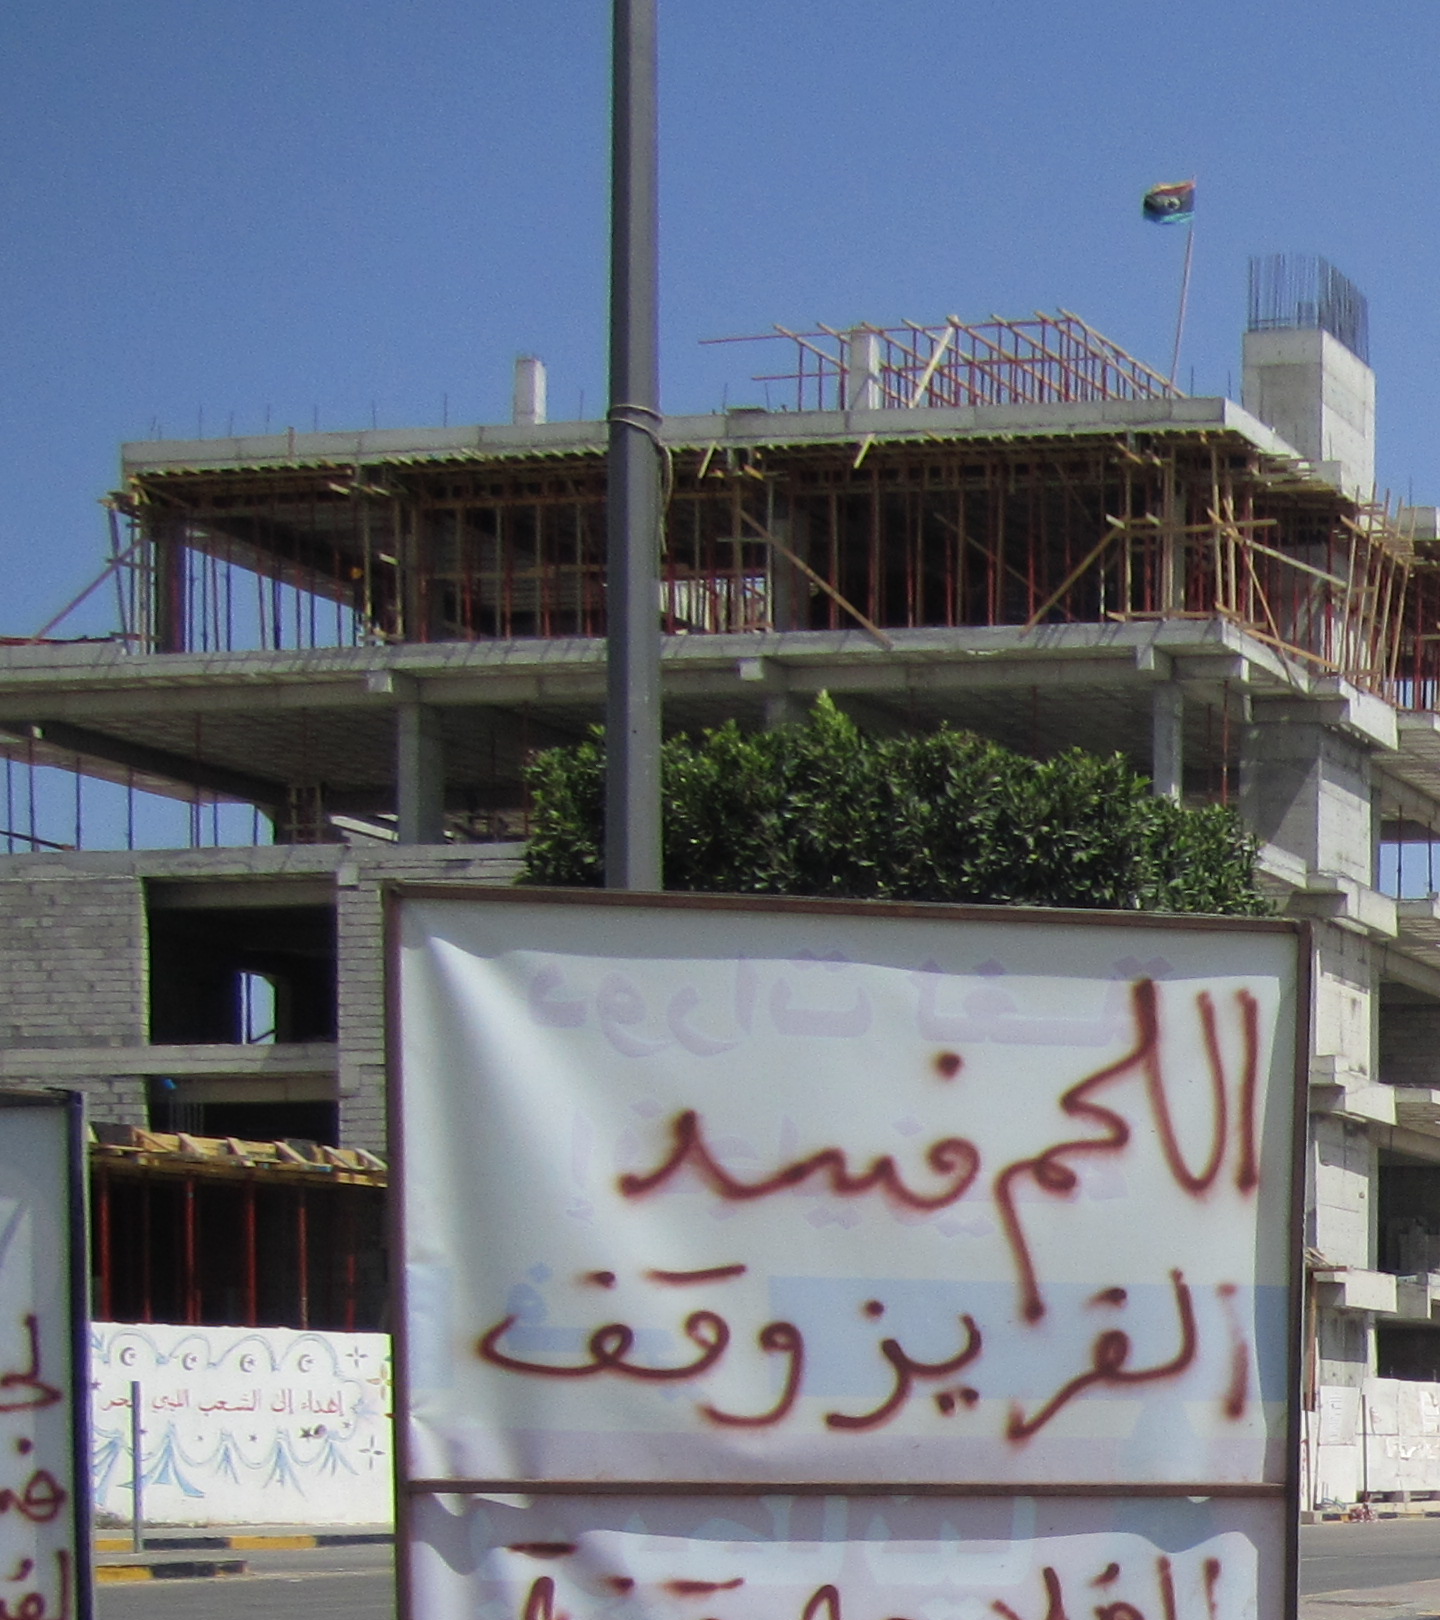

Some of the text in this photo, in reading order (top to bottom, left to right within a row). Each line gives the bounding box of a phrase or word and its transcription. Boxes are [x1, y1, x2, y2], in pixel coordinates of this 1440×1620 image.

[615, 978, 1262, 1323] اللحم فسد
[197, 1388, 262, 1417] الشعب
